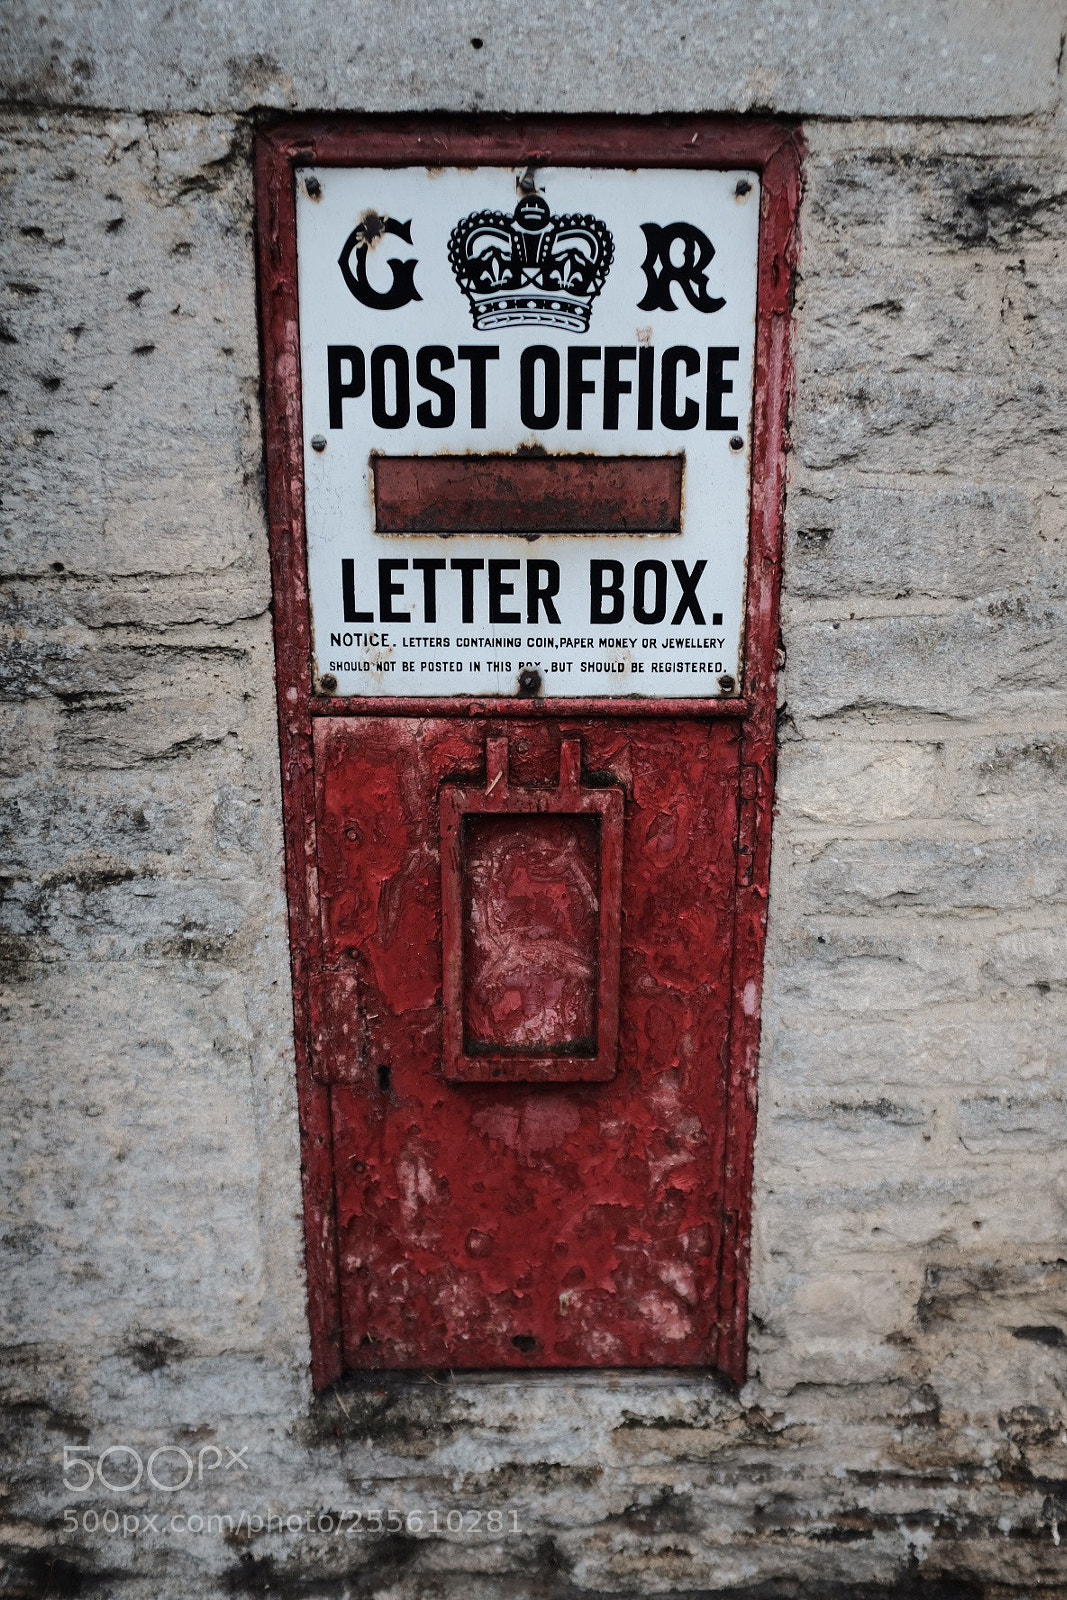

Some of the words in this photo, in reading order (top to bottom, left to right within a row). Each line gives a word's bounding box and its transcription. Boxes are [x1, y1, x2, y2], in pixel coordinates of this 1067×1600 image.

[337, 215, 424, 311] G
[636, 221, 727, 314] R
[327, 344, 500, 430] POST
[520, 345, 740, 431] OFFICE
[341, 558, 562, 625] LETTER
[589, 558, 723, 626] BOX.
[329, 661, 370, 672] SHOULD
[376, 661, 396, 672] NOT
[402, 661, 415, 672] BE
[420, 661, 463, 672] POSTED
[469, 661, 481, 672] IN
[486, 661, 512, 672] THIS
[580, 661, 625, 673] SHOULD
[631, 661, 645, 673] BE
[651, 661, 727, 673] REGISTERED.
[330, 632, 397, 647] NOTICE.
[402, 637, 450, 648] LETTERS
[456, 637, 522, 648] CONTAINING
[599, 638, 638, 649] MONEY
[641, 638, 658, 649] OR
[661, 638, 726, 649] JEWELLERY
